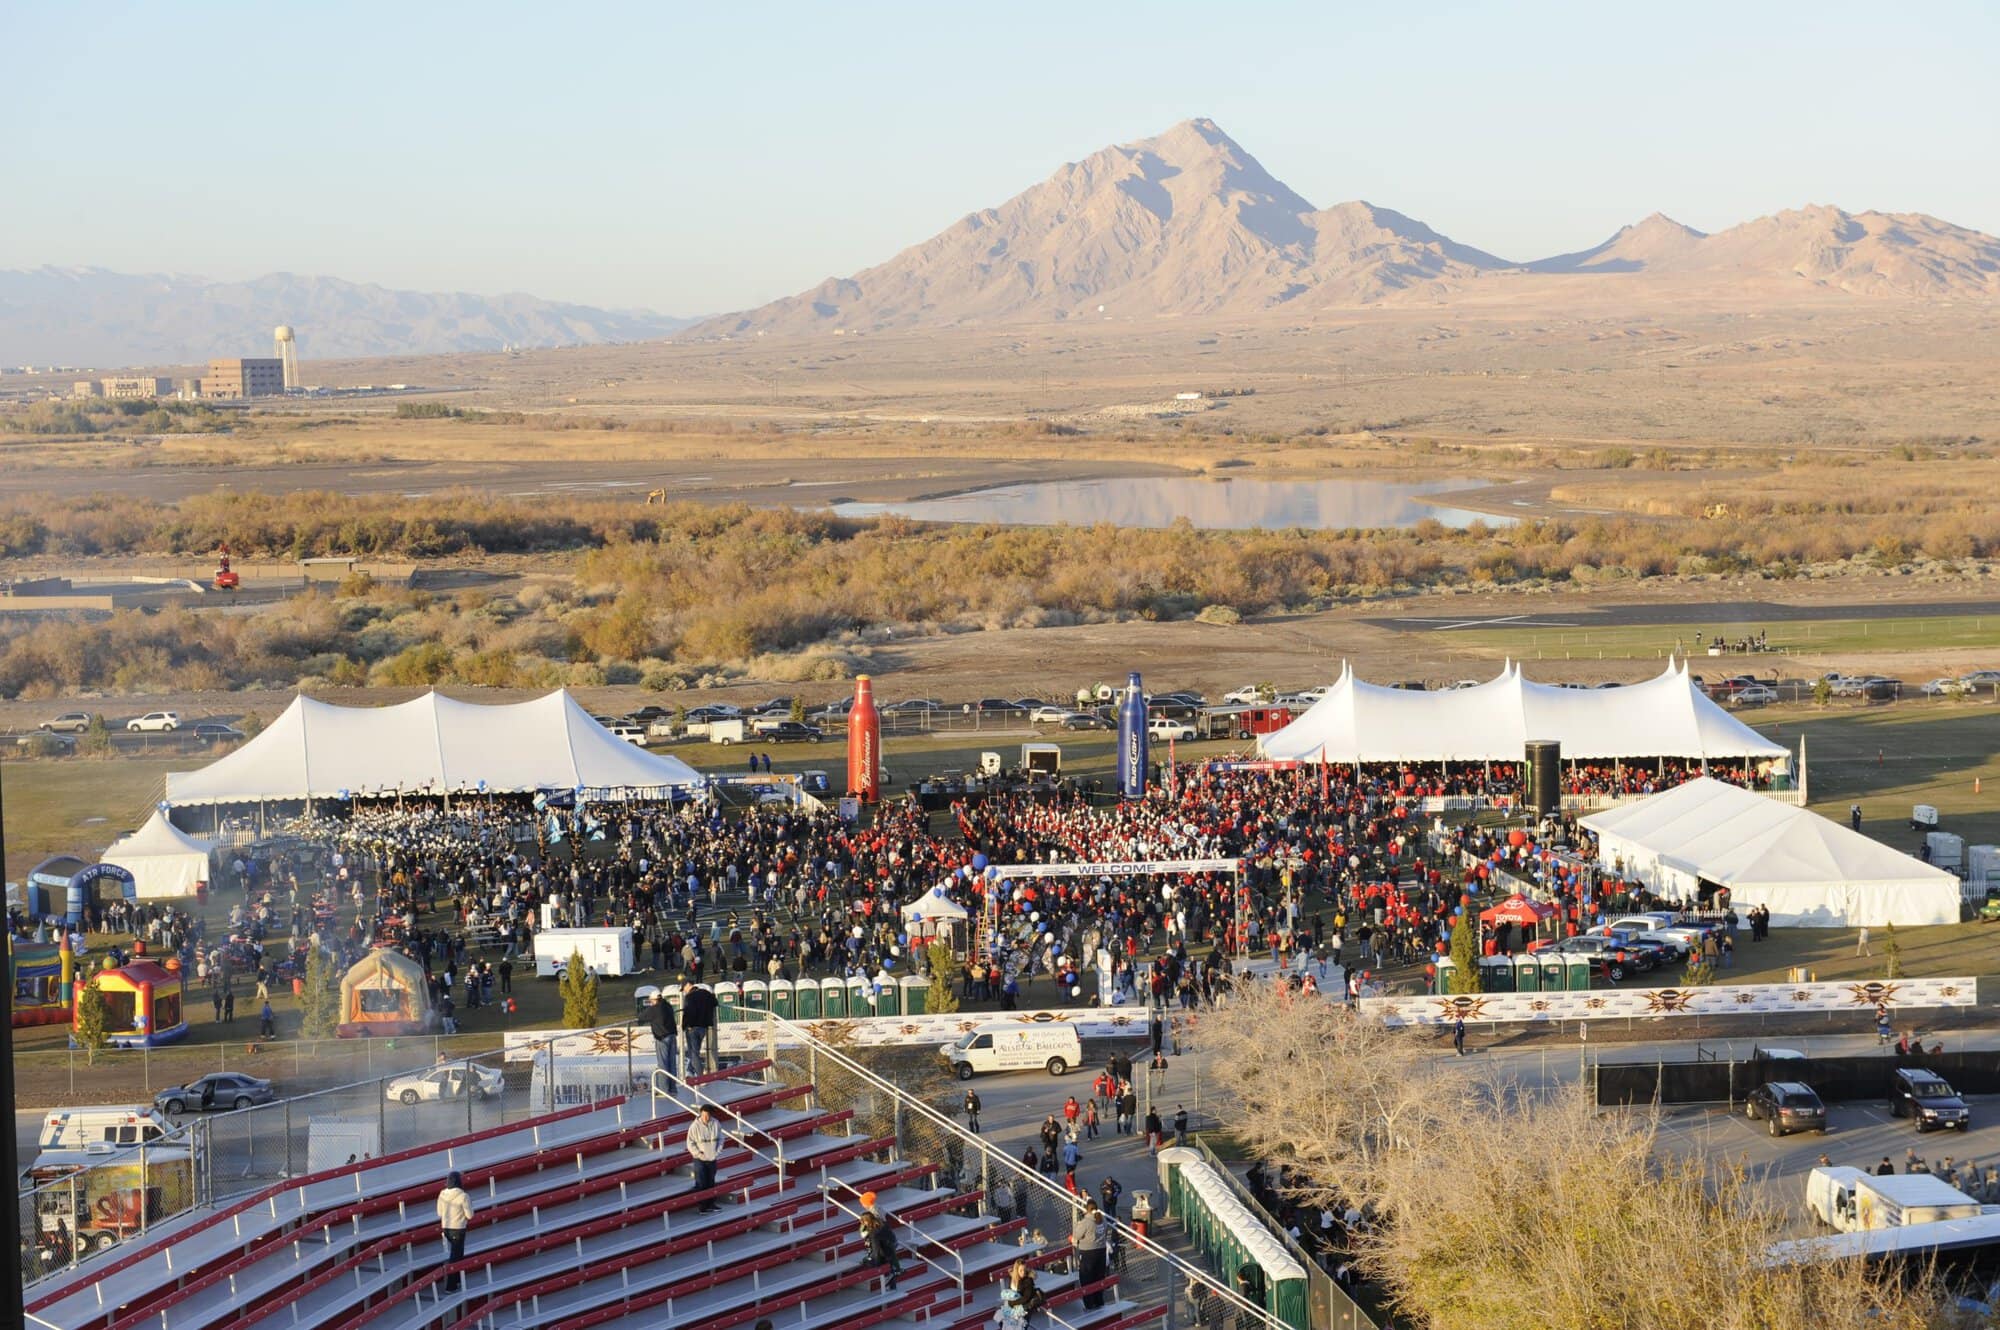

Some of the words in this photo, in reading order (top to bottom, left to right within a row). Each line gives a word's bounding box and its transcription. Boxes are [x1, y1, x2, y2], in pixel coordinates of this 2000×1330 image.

[82, 868, 98, 882] AIR
[101, 865, 127, 879] FORCE
[1078, 864, 1156, 874] WELCOME
